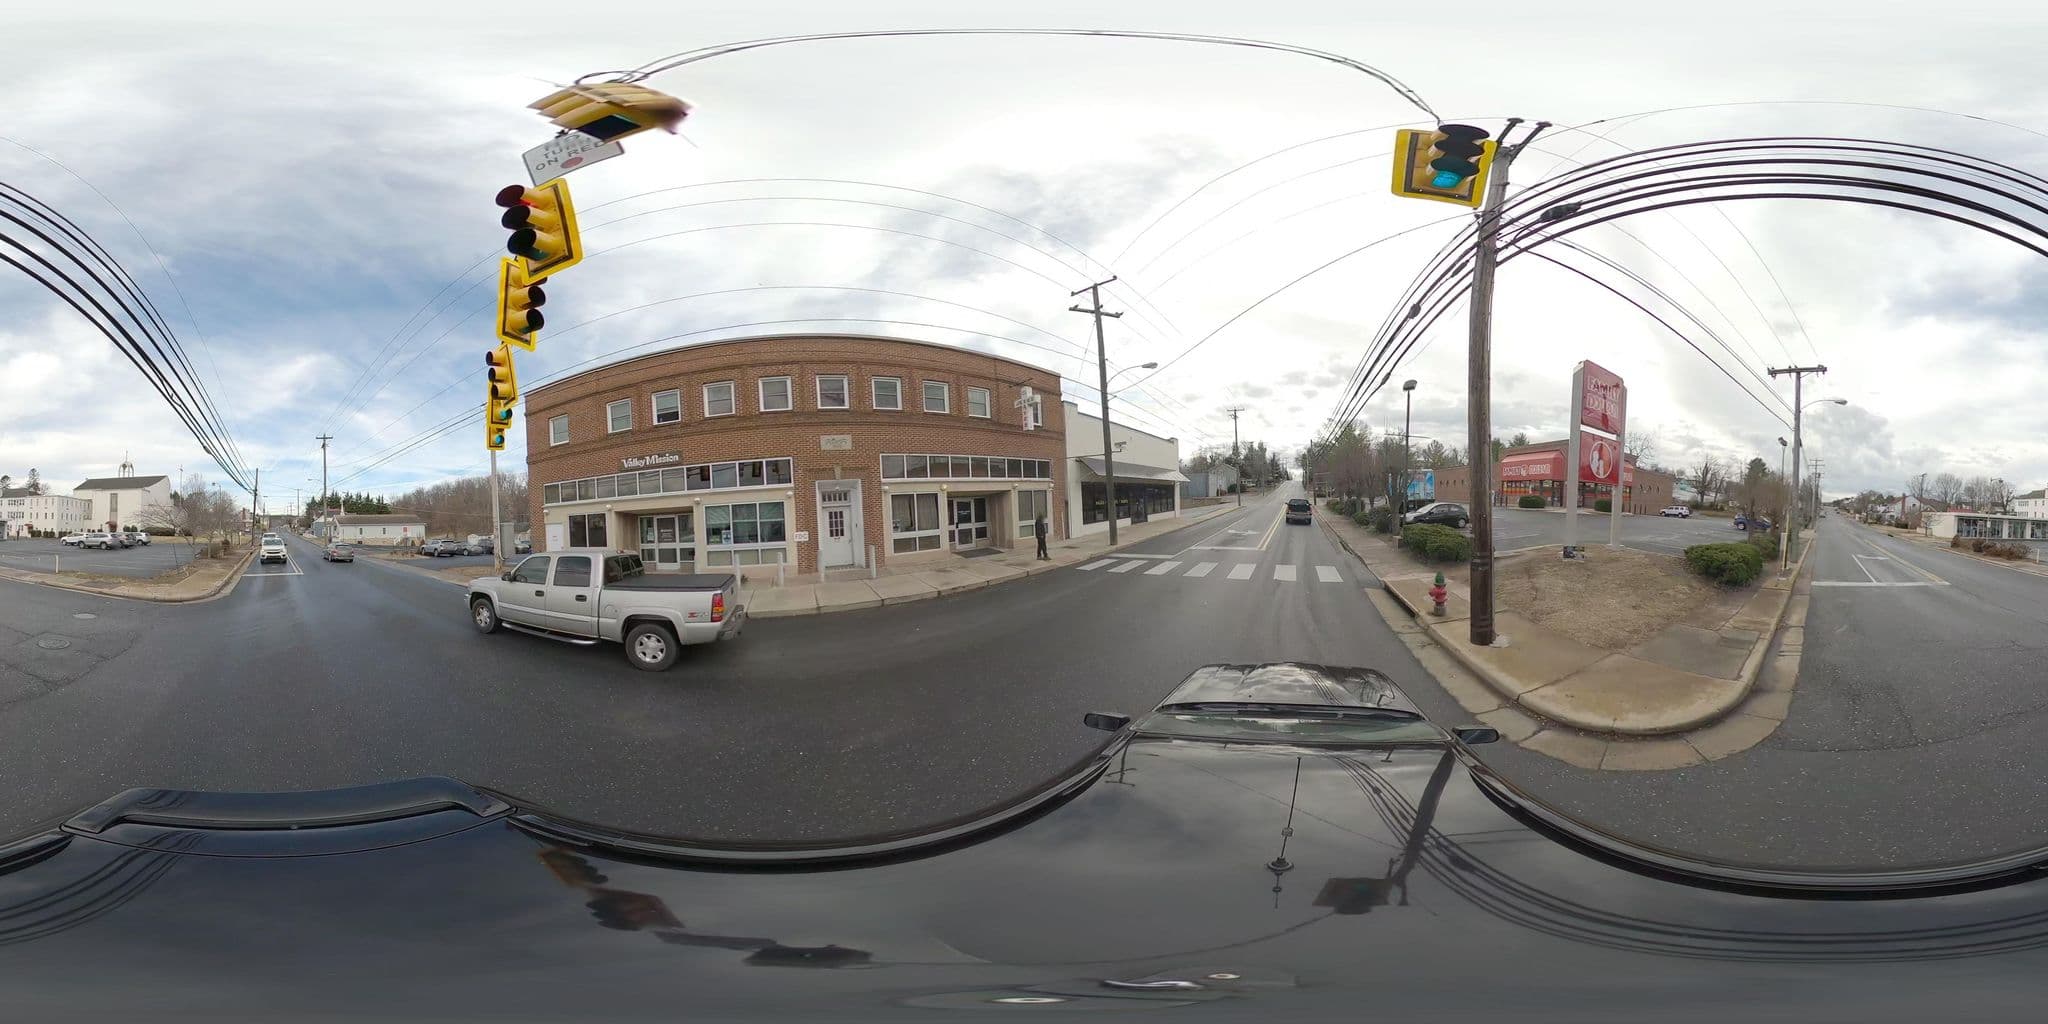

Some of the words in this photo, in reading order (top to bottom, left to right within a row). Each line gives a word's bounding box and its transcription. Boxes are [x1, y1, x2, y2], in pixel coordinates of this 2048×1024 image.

[535, 158, 558, 171] ON
[567, 140, 605, 157] RED
[621, 457, 645, 468] Valley
[644, 453, 679, 465] Mission
